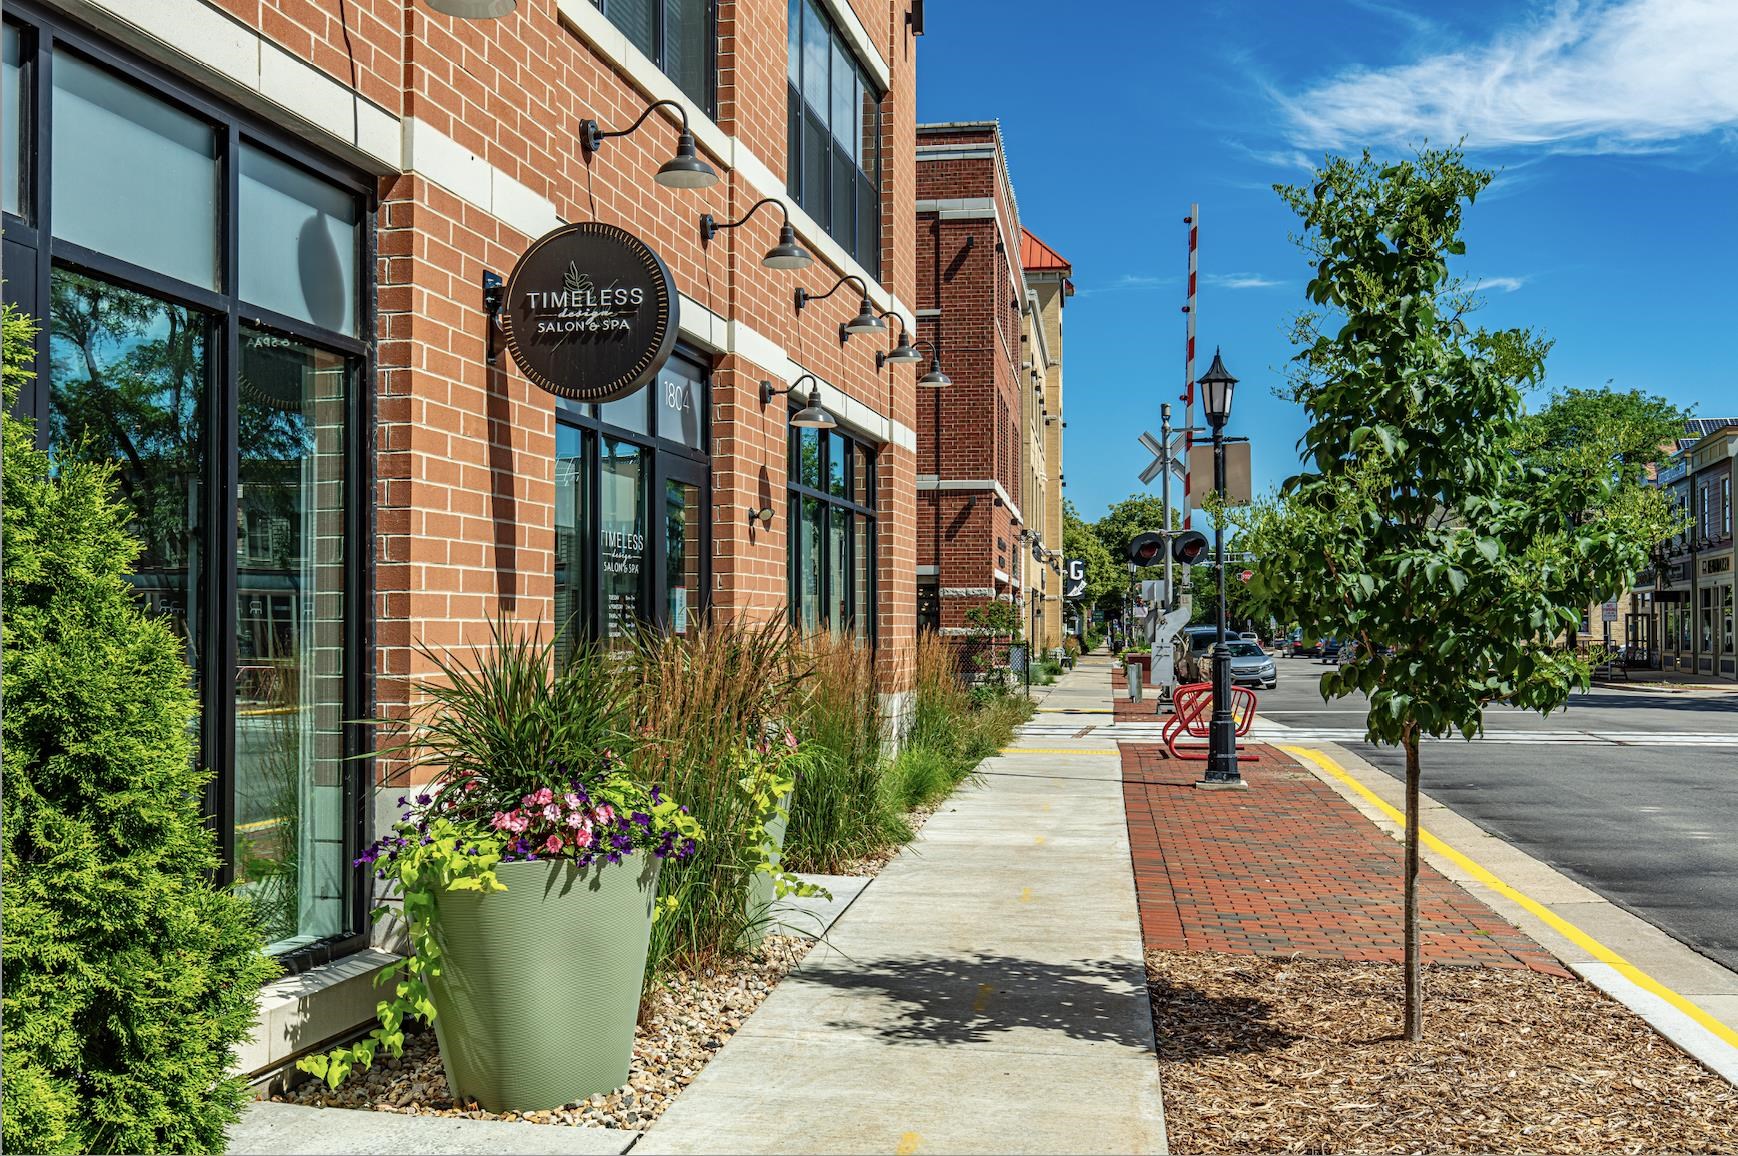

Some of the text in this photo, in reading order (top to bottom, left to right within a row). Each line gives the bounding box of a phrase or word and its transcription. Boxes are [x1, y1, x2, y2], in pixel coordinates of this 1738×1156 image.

[526, 287, 644, 309] TIMELESS
[537, 319, 630, 333] SALON & SPA
[557, 307, 613, 325] design
[664, 381, 690, 413] 1804
[601, 529, 644, 551] TIMELESS
[603, 561, 623, 573] SALON
[628, 563, 639, 574] SPA
[1070, 560, 1083, 580] G
